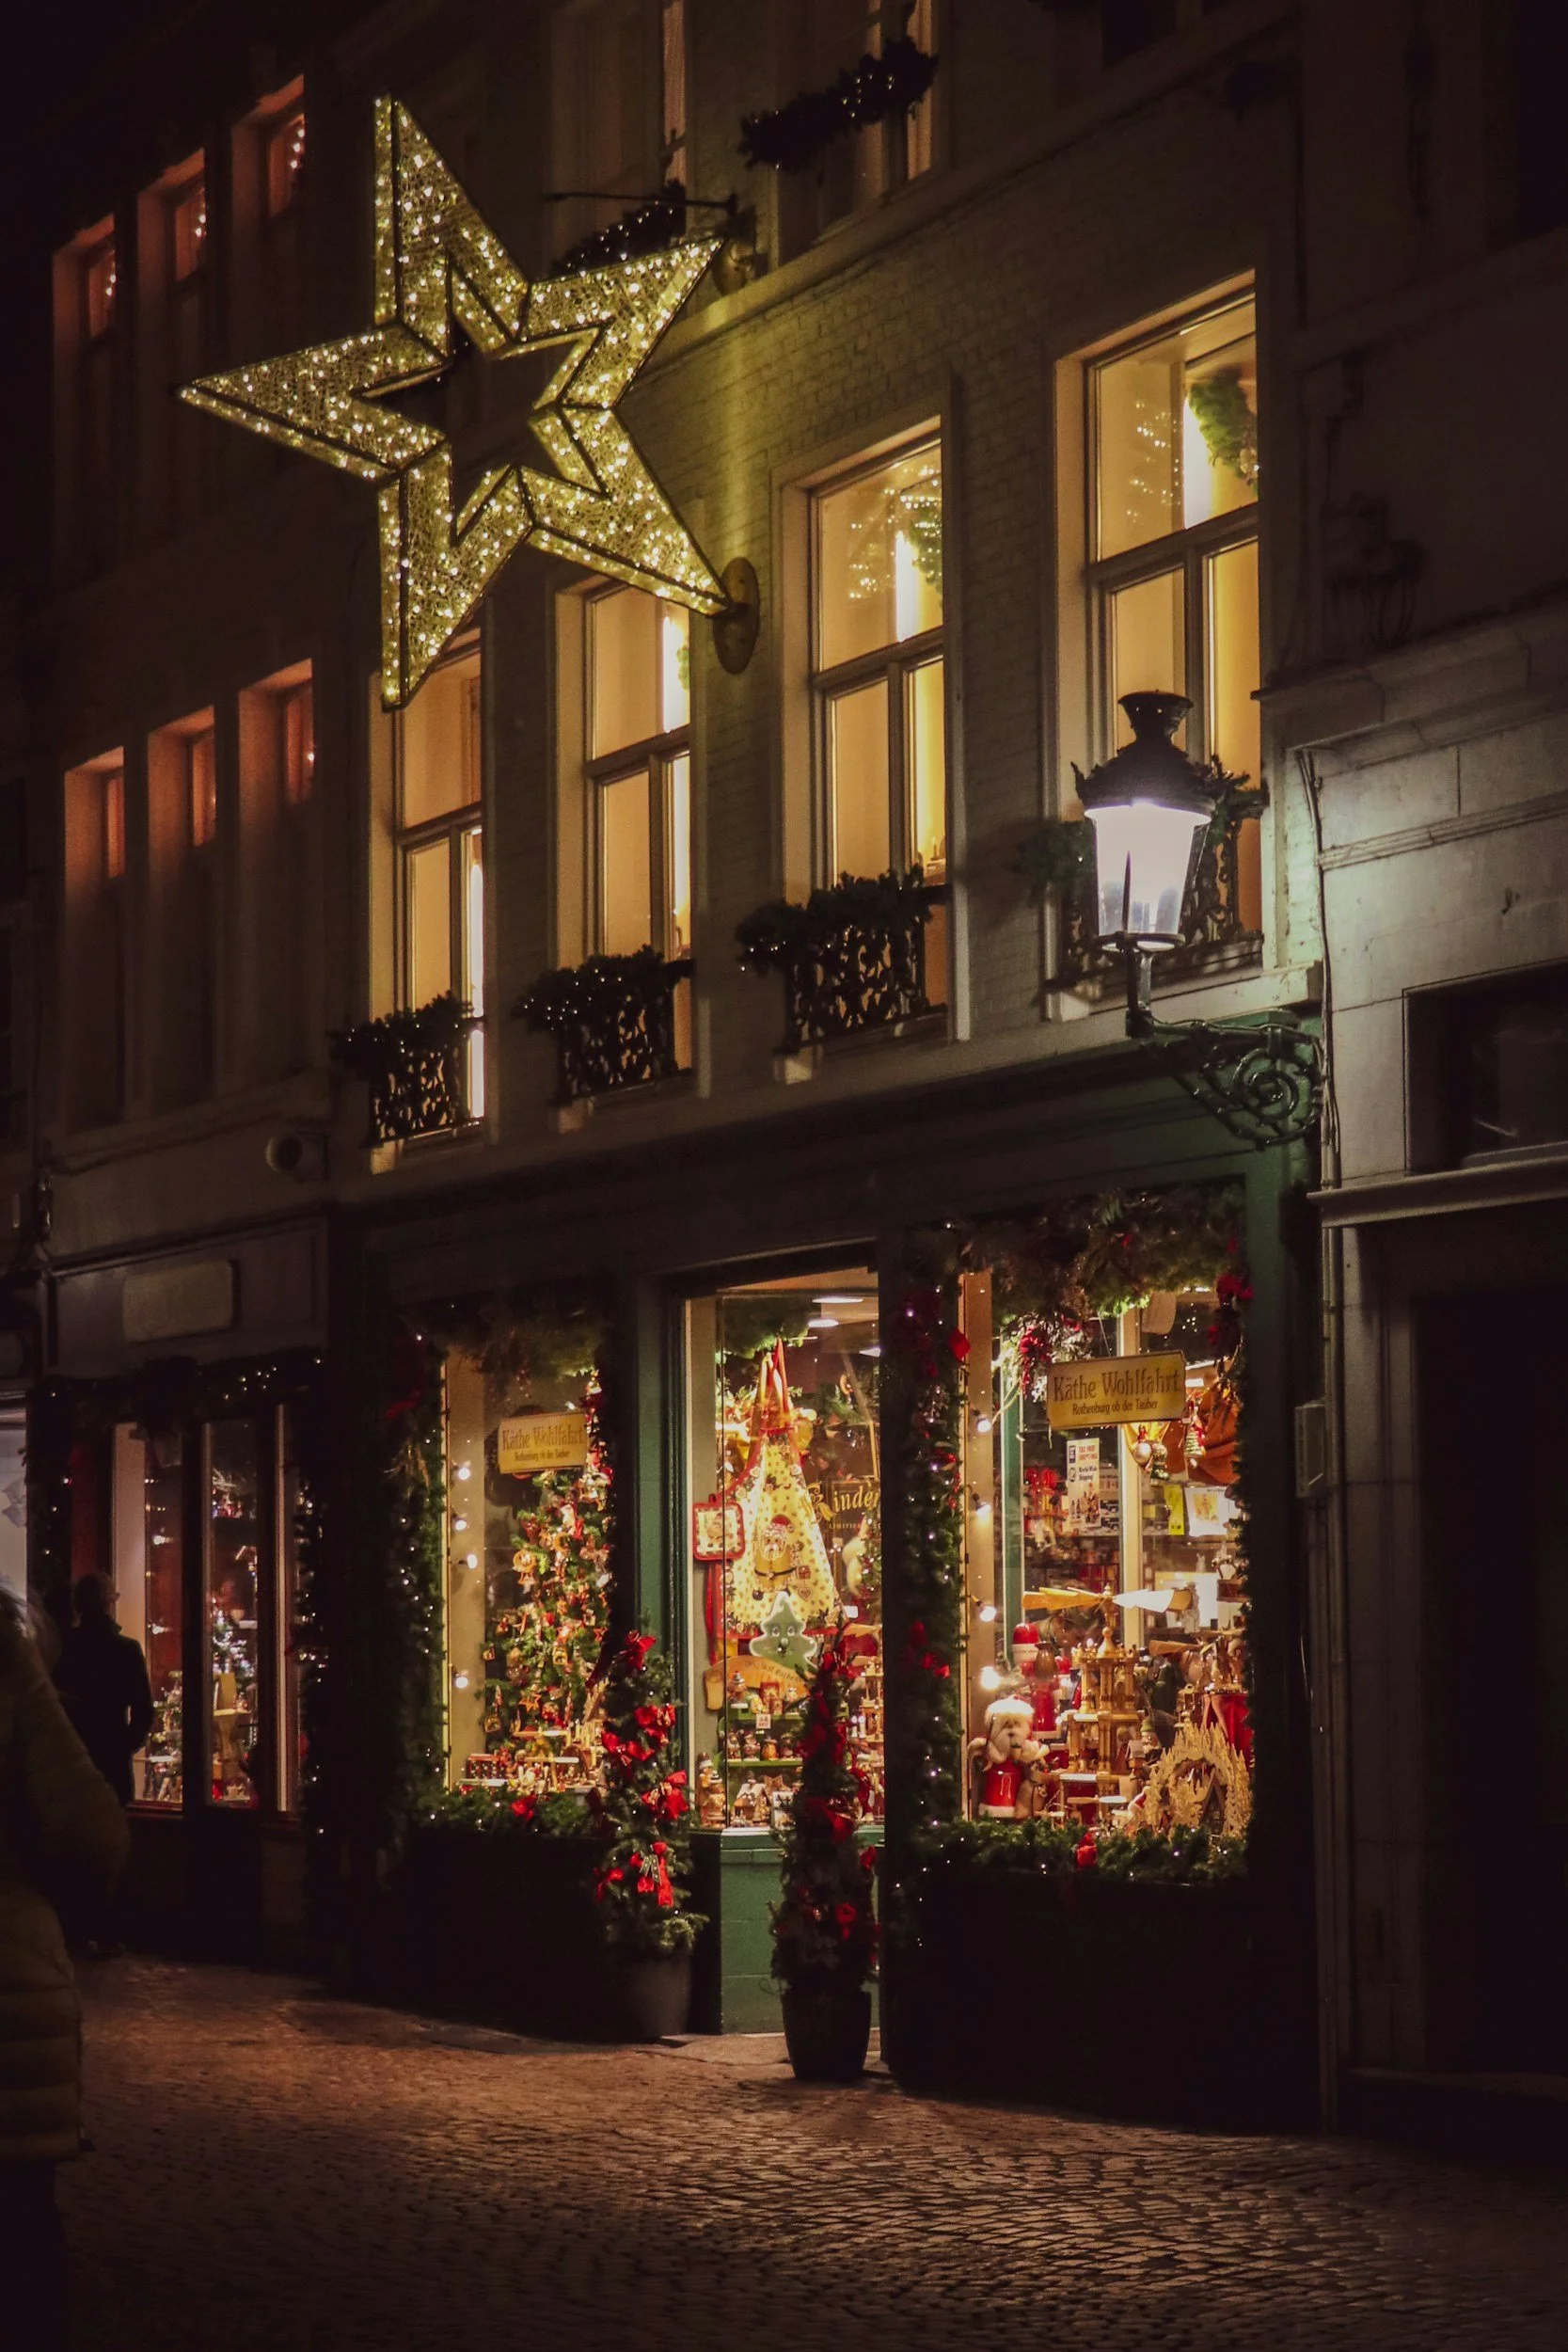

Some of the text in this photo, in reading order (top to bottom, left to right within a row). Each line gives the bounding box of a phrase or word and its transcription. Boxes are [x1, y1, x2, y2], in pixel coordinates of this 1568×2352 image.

[1053, 1367, 1181, 1402] Käthe Wohlfahrt
[1072, 1398, 1159, 1415] Rothenburg ob der Tauber
[533, 1423, 584, 1447] Wohlfahrt
